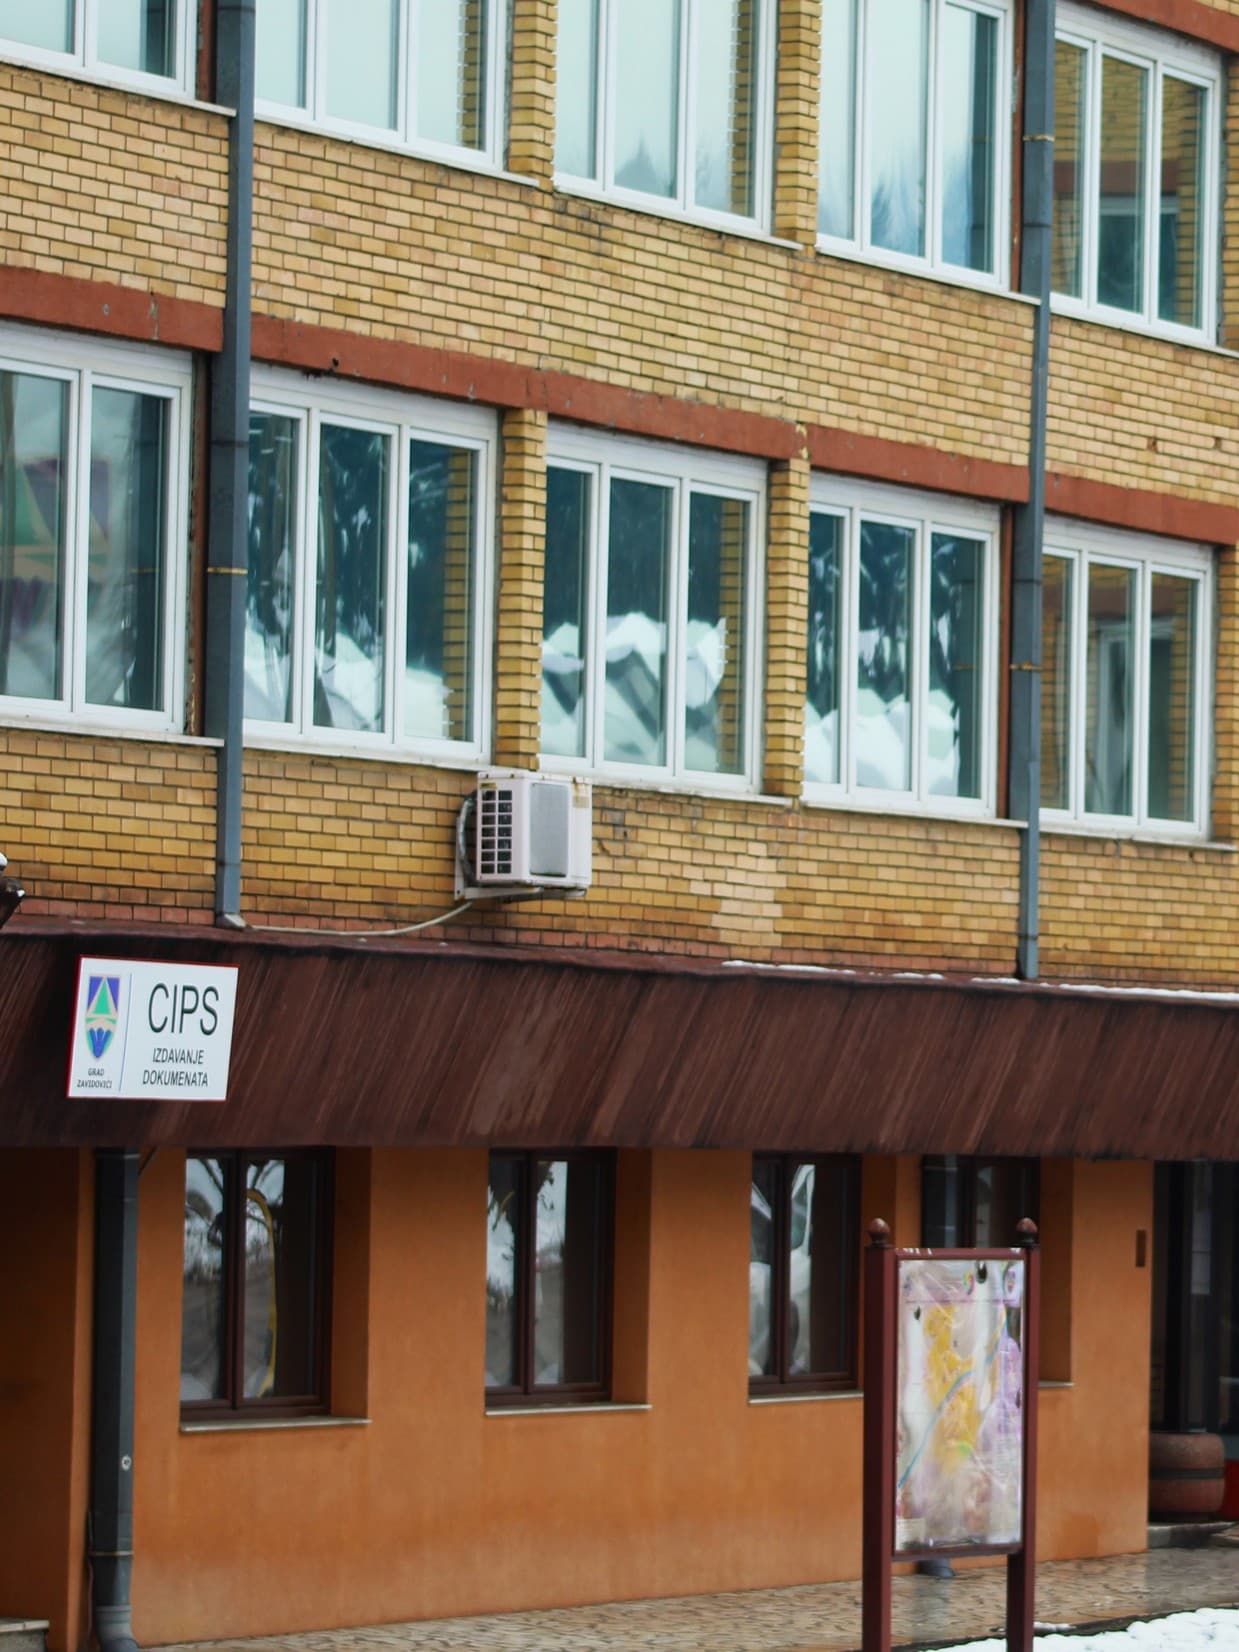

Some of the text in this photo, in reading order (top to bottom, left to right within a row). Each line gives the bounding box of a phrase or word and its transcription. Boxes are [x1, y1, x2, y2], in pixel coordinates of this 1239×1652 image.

[148, 982, 219, 1036] CIPS
[152, 1047, 204, 1065] IZDAVANJE
[87, 1067, 105, 1077] GRAD
[142, 1069, 208, 1088] DOKUMENATA
